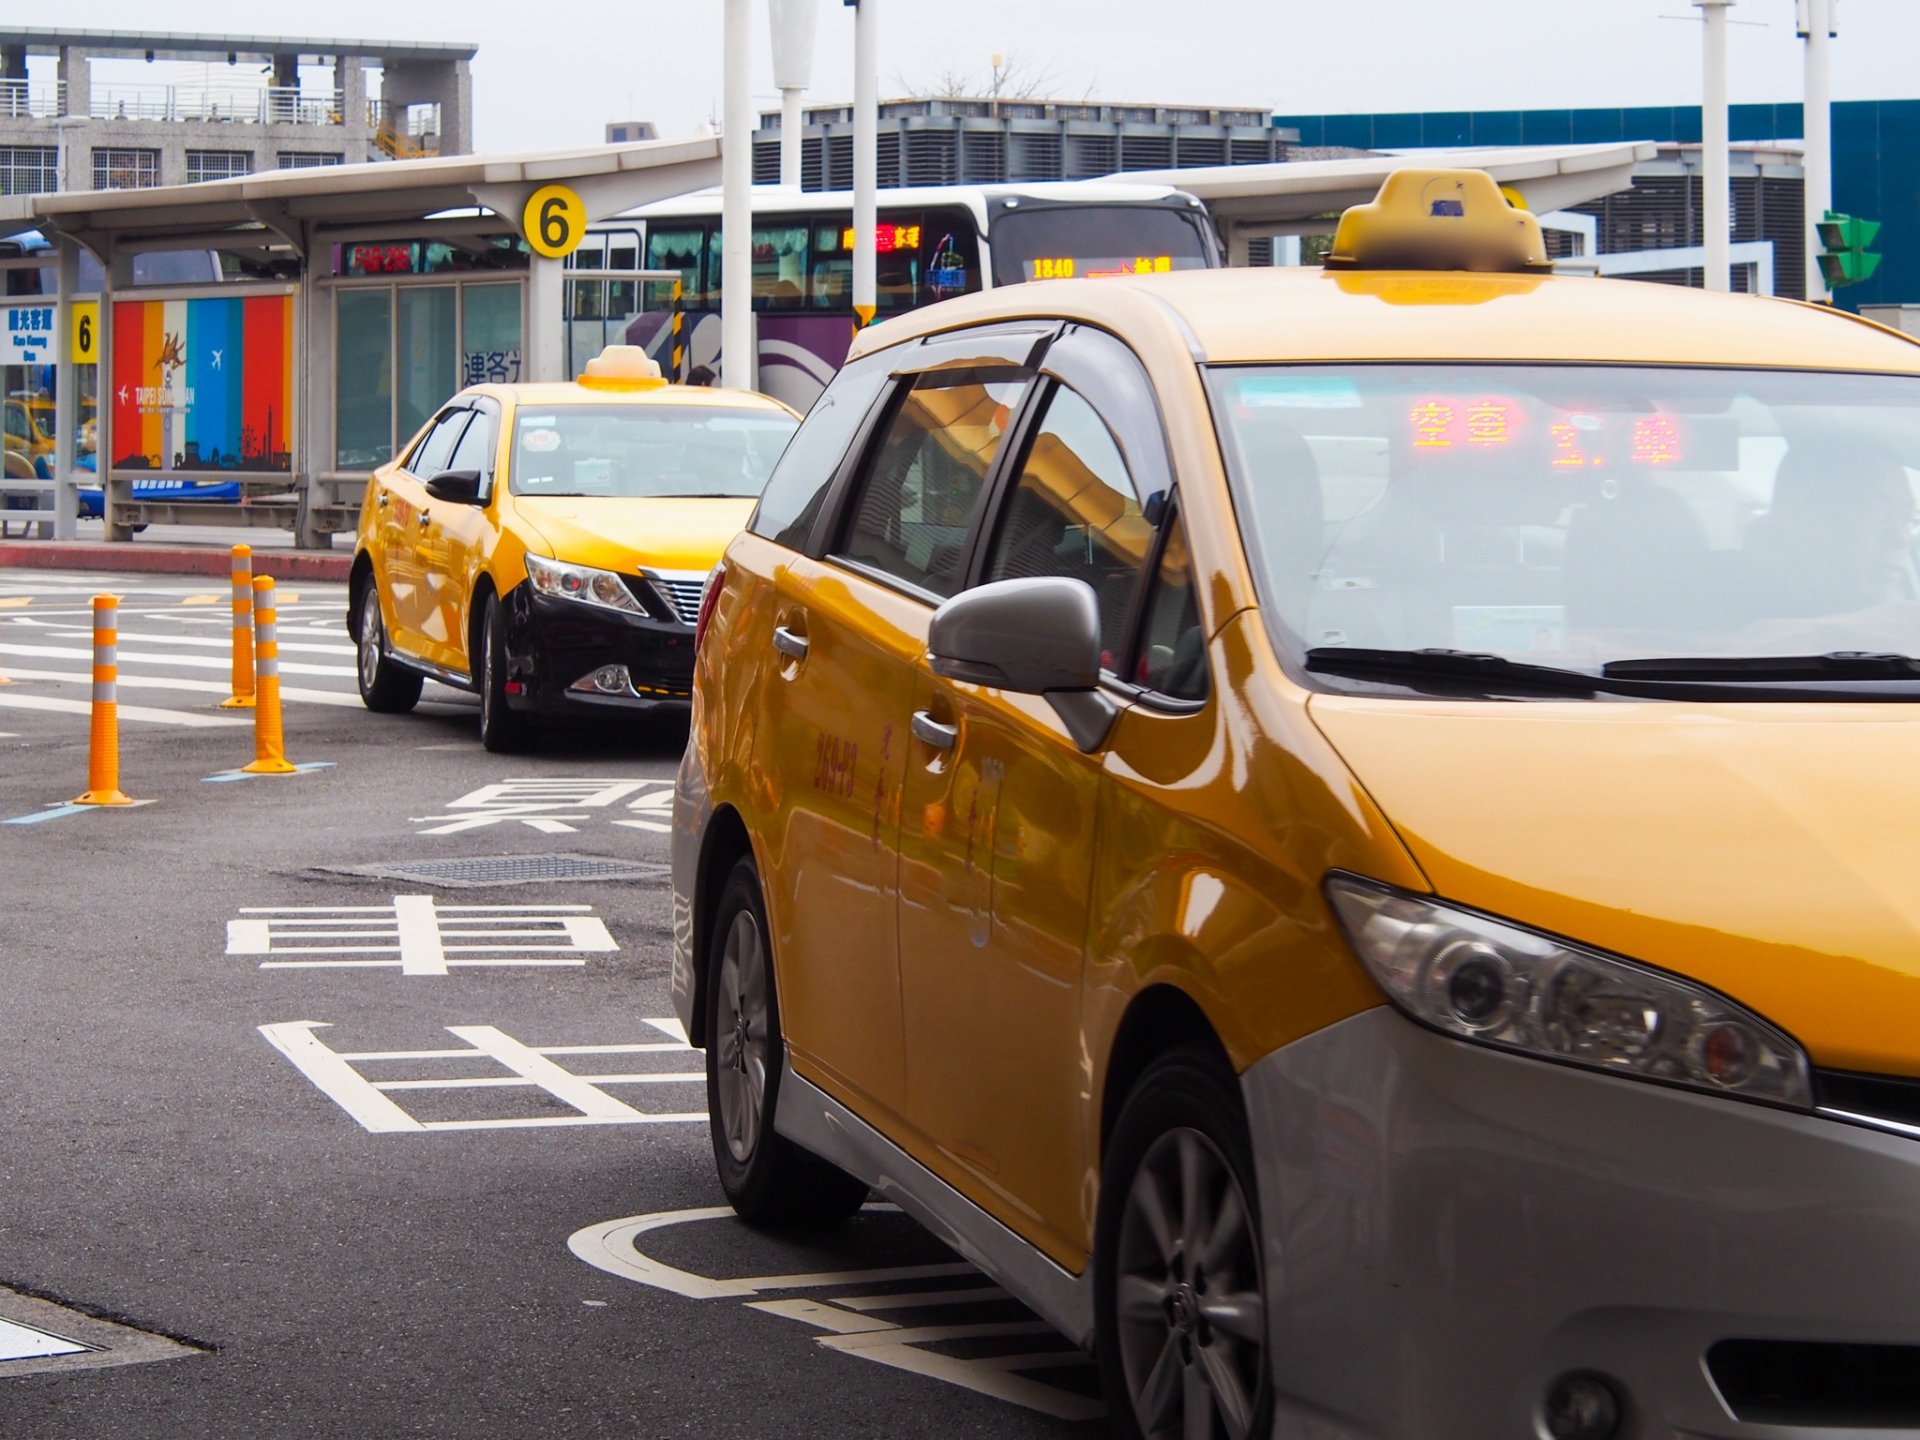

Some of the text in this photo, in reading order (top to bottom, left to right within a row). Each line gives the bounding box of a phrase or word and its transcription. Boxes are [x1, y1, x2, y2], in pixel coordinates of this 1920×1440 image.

[540, 197, 569, 248] 6
[1033, 258, 1073, 279] 1840
[79, 314, 91, 353] 6
[135, 387, 195, 405] TAIPEI SONAN
